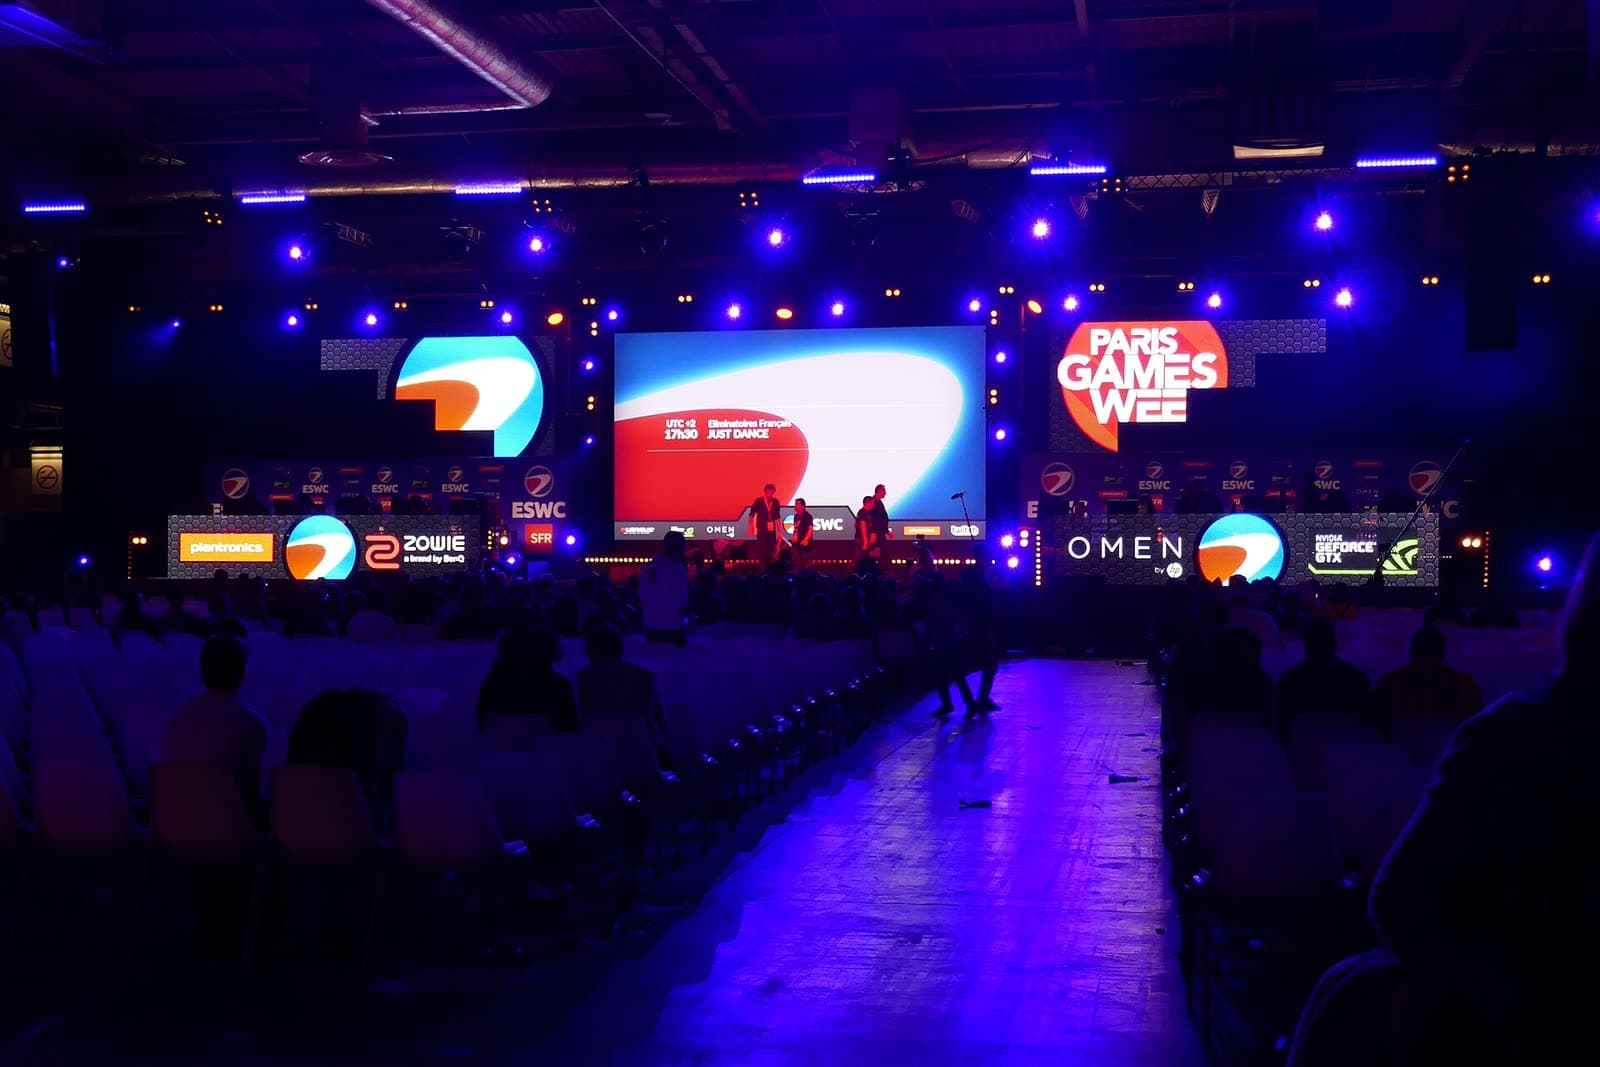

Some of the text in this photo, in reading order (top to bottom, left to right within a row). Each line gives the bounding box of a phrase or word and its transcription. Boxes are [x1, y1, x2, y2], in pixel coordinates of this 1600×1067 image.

[1090, 327, 1178, 355] PARIS
[1057, 352, 1218, 391] GAMES
[1089, 388, 1187, 424] WEE
[666, 419, 696, 428] UTC +2
[664, 429, 698, 440] 17h30
[707, 429, 769, 439] JUST DANCE
[302, 484, 329, 494] ESWC
[371, 484, 399, 494] ESWC
[441, 483, 469, 493] ESWC
[1139, 480, 1171, 490] ESWC
[1222, 480, 1255, 490] ESWC
[1314, 480, 1341, 490] SWC
[511, 502, 567, 519] ESWC
[706, 526, 735, 534] OMEN
[812, 518, 844, 531] SWC
[951, 525, 979, 536] twith
[403, 535, 465, 551] ZOWIE
[530, 532, 552, 544] SFR
[1315, 534, 1343, 542] NVIDIA
[190, 542, 264, 554] plantronics
[1067, 536, 1183, 560] OMEN
[1315, 541, 1375, 553] GEFORCE
[410, 554, 432, 563] brand
[433, 554, 442, 564] by
[443, 554, 465, 563] BenQ
[1315, 552, 1342, 563] GTX
[1154, 566, 1166, 575] by
